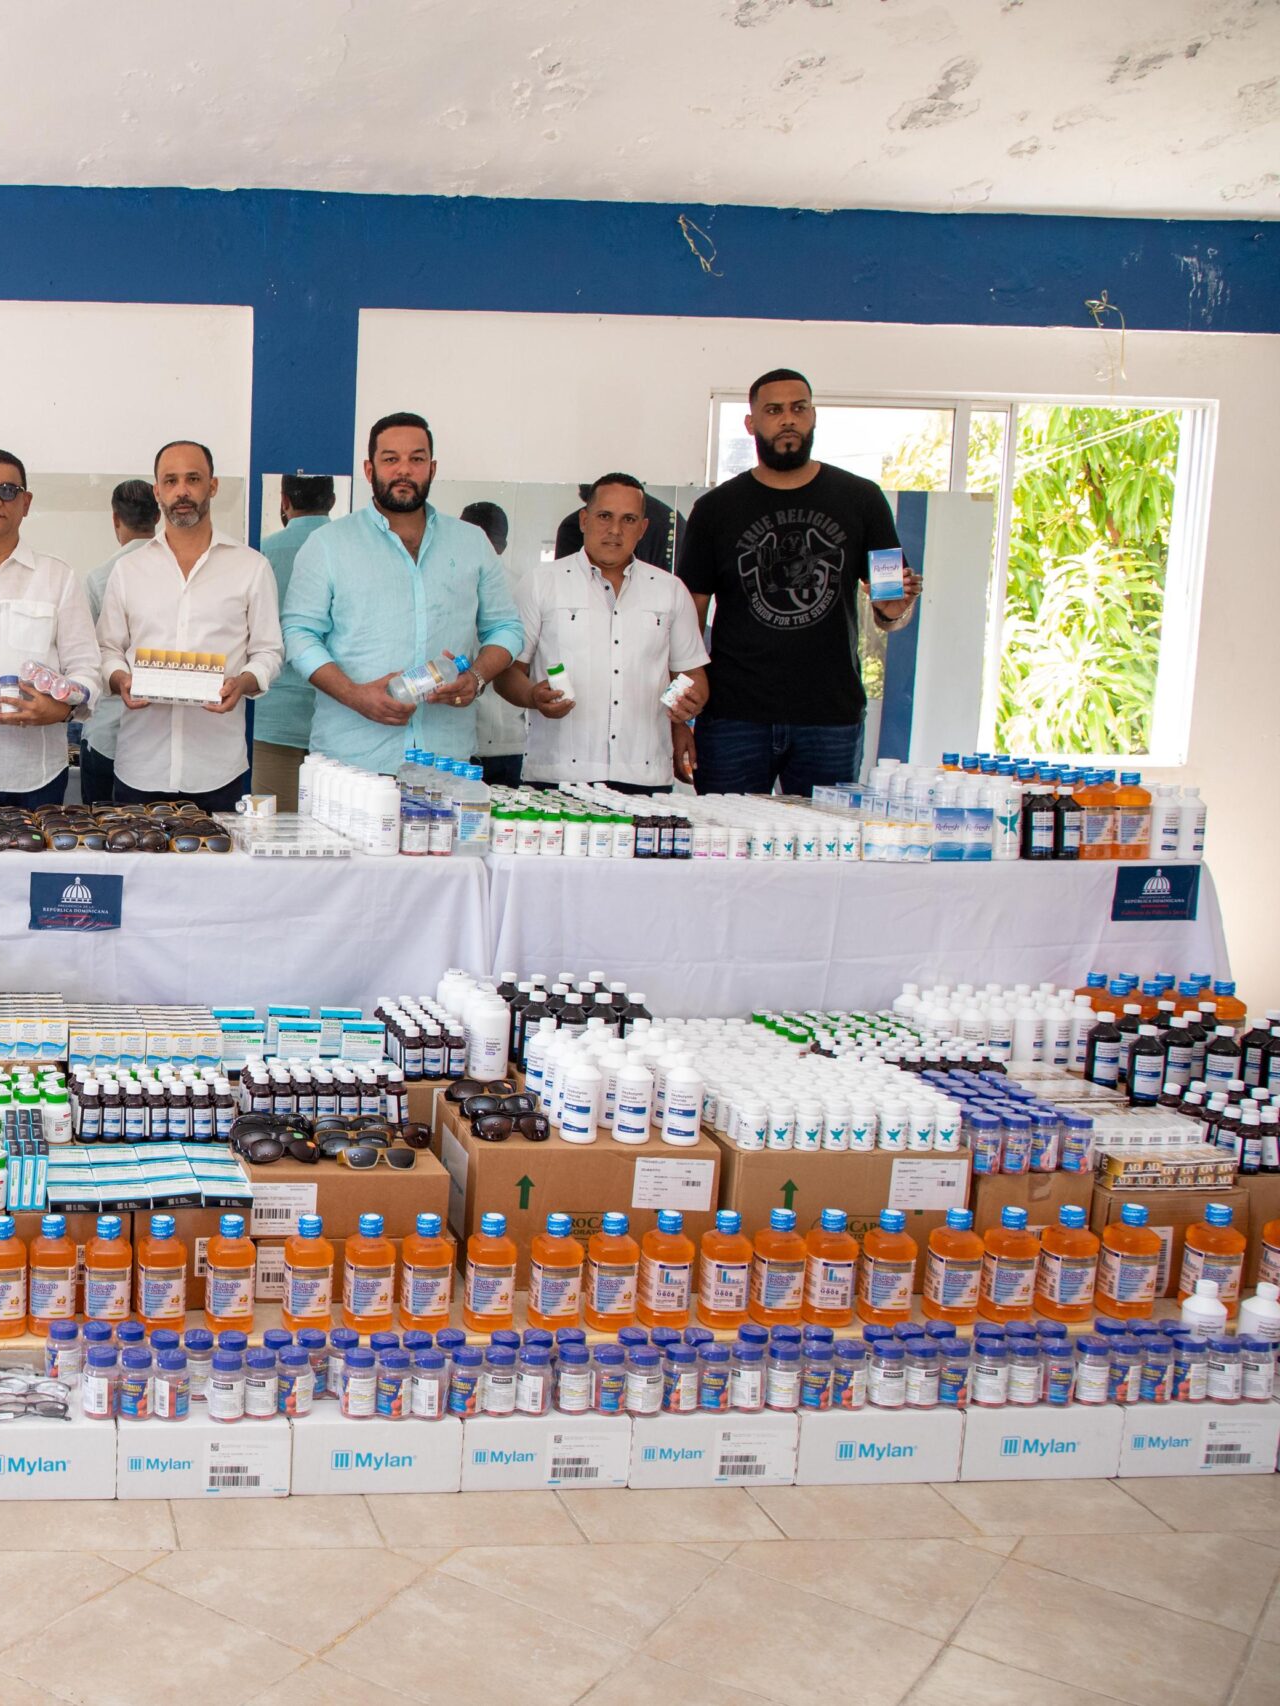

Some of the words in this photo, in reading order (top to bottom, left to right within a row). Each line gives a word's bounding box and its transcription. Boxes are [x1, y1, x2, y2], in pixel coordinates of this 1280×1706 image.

[735, 515, 775, 552] TRUE
[776, 508, 848, 545] RELIGION
[872, 563, 900, 573] Refresh
[751, 591, 773, 622] FASHION
[773, 614, 790, 626] FOR
[792, 613, 811, 626] THE
[811, 588, 836, 619] SENSES
[935, 822, 961, 832] Refresh
[858, 1441, 915, 1460] Mylan
[1021, 1438, 1079, 1456] Mylan
[1147, 1435, 1190, 1450] Mylan
[355, 1451, 414, 1471] Mylan
[490, 1448, 535, 1465] Mylan
[658, 1446, 704, 1463] Mylan
[7, 1455, 68, 1476] Mylan
[145, 1456, 192, 1473] Mylan
